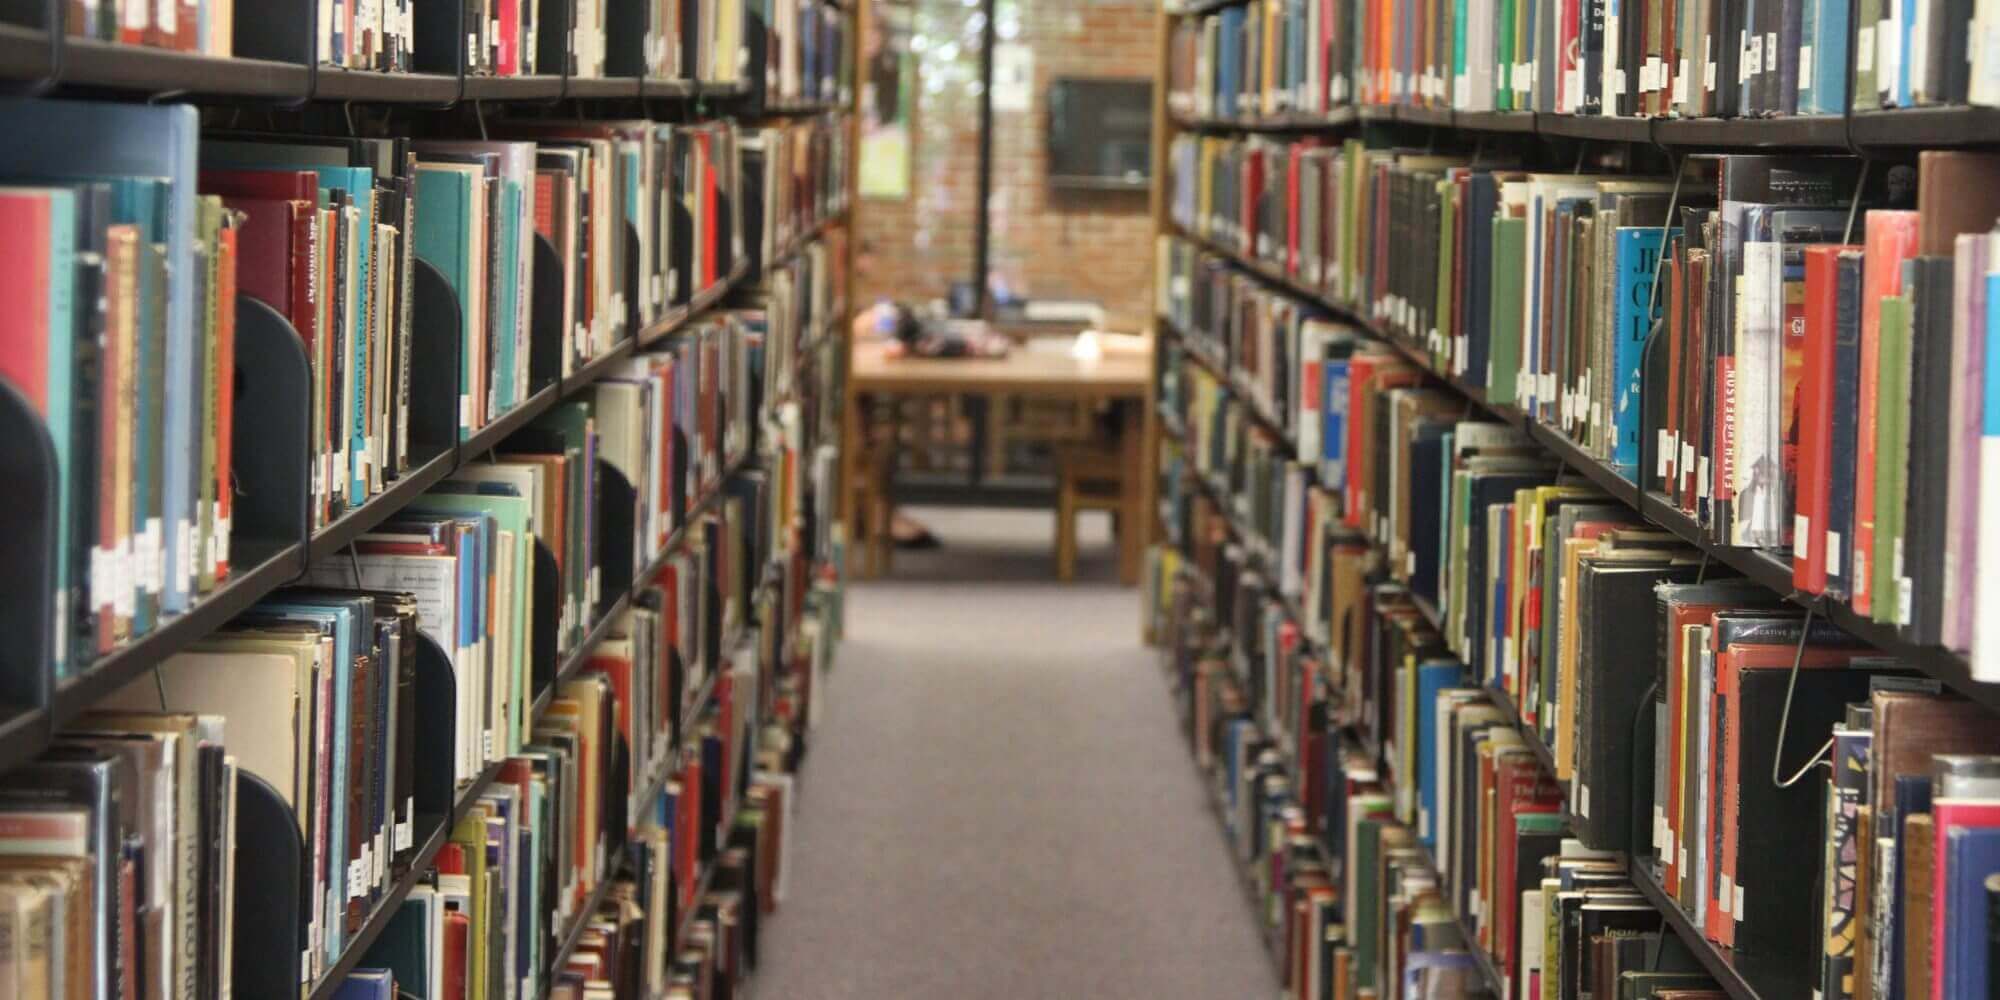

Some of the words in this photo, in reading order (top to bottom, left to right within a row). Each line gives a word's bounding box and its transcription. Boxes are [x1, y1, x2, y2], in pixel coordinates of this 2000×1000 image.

[356, 351, 364, 440] Theology
[1725, 370, 1736, 421] REASON
[1724, 447, 1734, 489] FAITH
